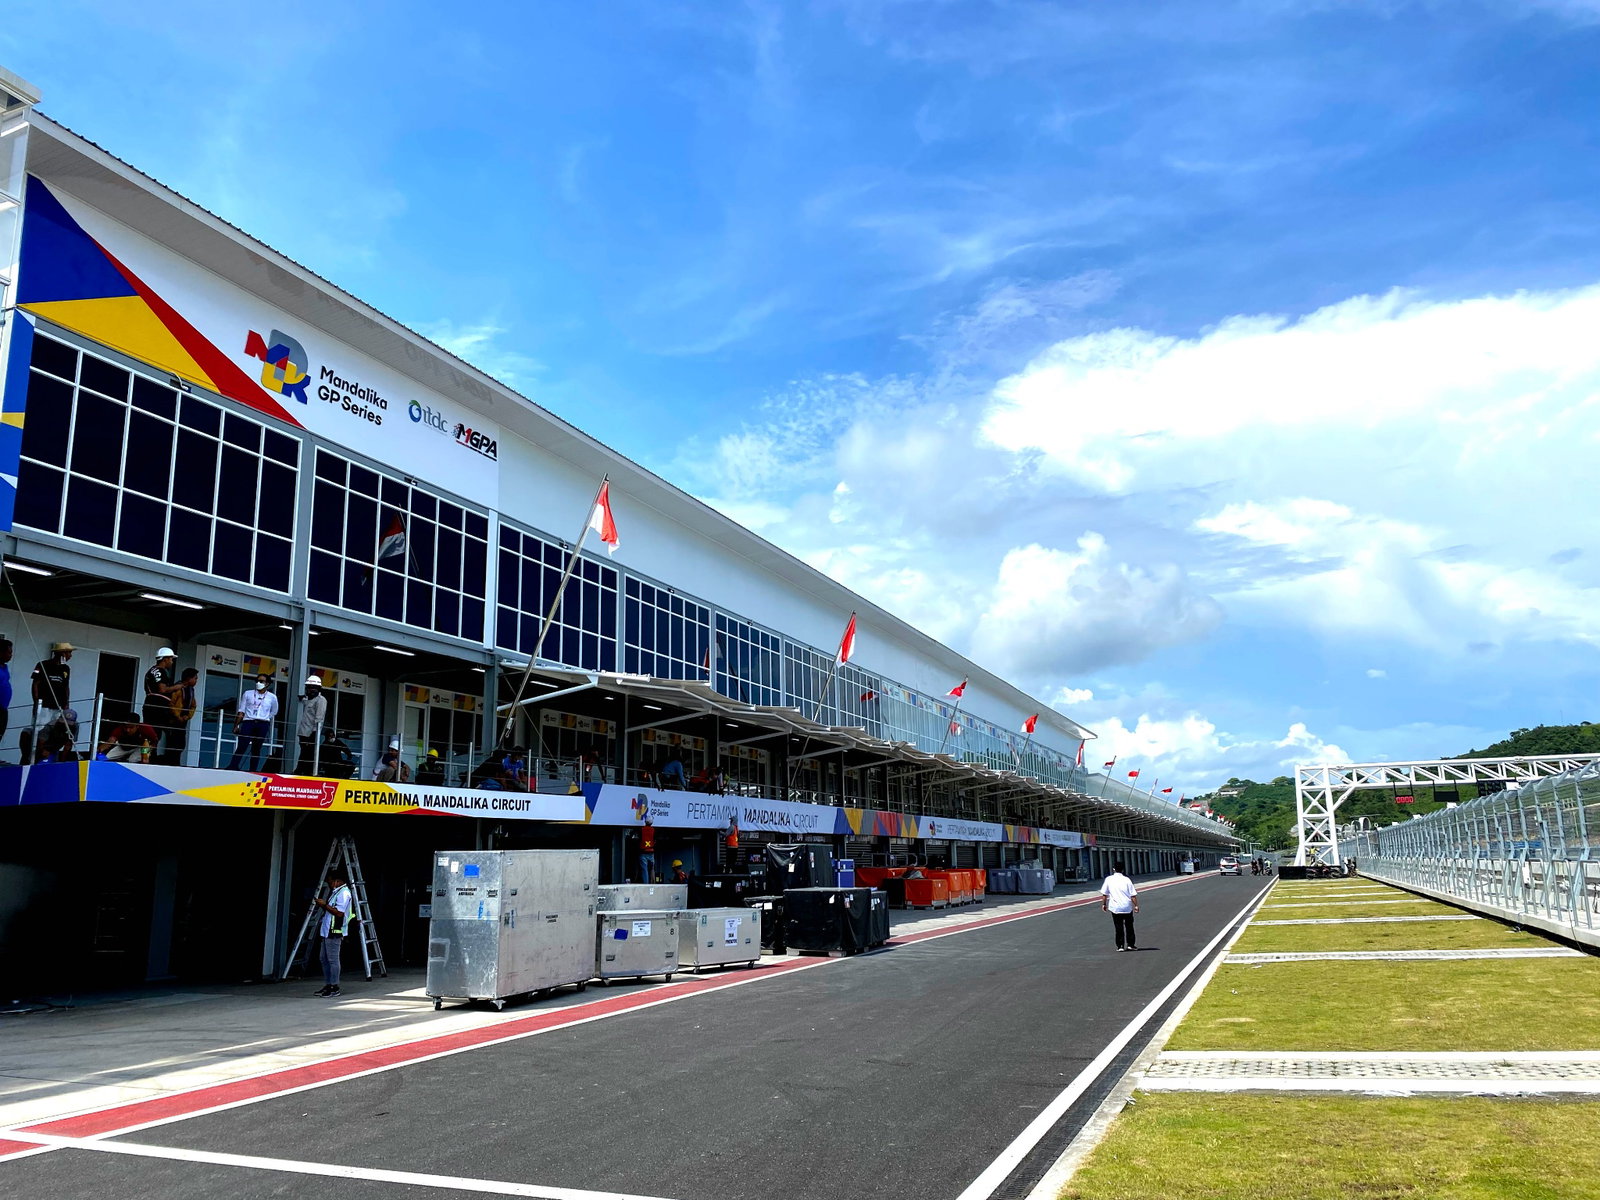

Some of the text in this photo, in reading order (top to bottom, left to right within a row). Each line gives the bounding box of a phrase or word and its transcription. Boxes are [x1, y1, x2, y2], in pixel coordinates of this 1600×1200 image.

[319, 365, 388, 410] Mandalika
[317, 385, 382, 426] GP Series
[268, 785, 322, 795] PERTAMINA MANDALIKA
[345, 789, 532, 812] PERTAMINA MANDALIKA CIRCUIT
[650, 800, 671, 808] Mandalika
[744, 807, 791, 826] MANDALIKA
[792, 813, 819, 829] CIRCUIT
